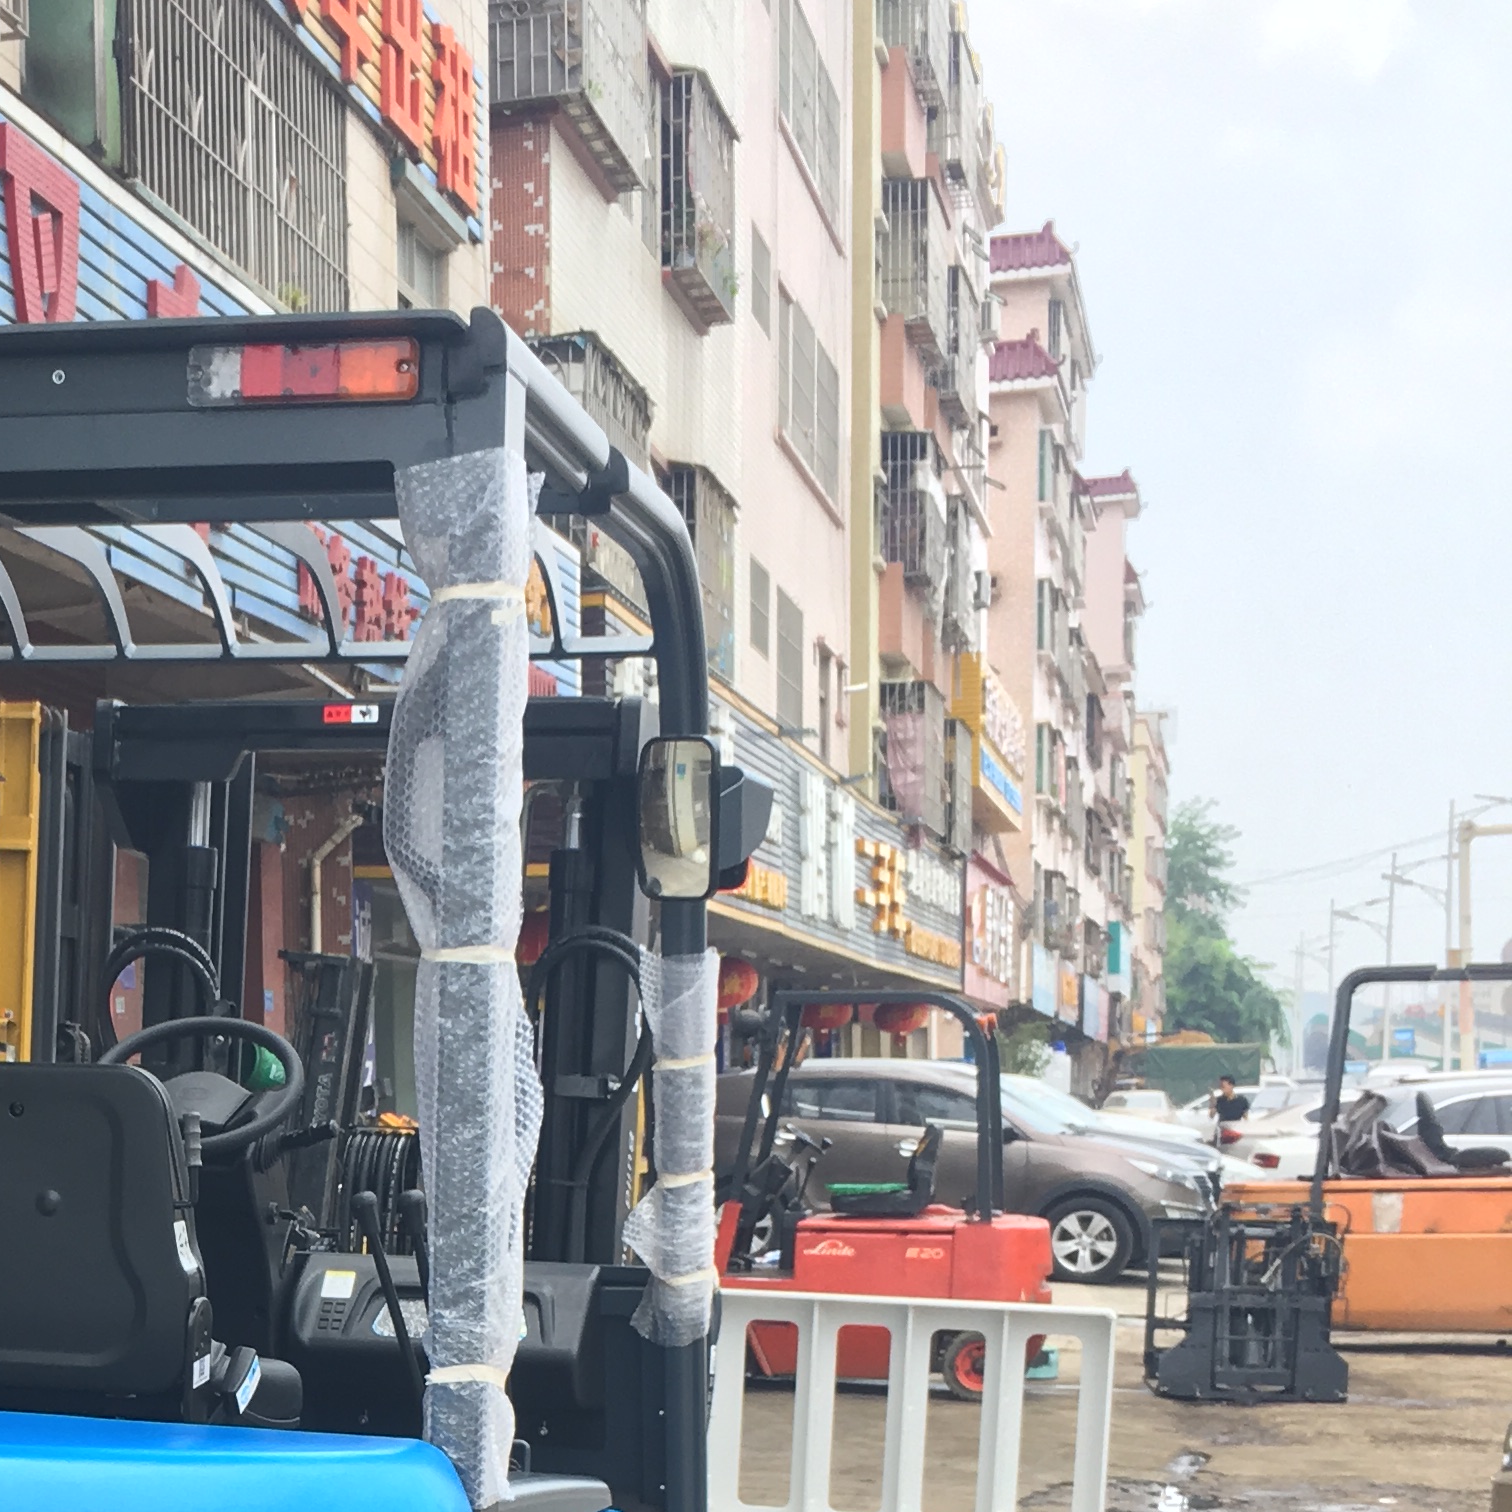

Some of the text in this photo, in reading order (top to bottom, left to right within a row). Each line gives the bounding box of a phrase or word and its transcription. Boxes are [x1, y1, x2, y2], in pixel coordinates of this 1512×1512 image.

[288, 0, 478, 217] 车出租
[311, 1073, 333, 1126] YOTA
[803, 1239, 857, 1258] Linde
